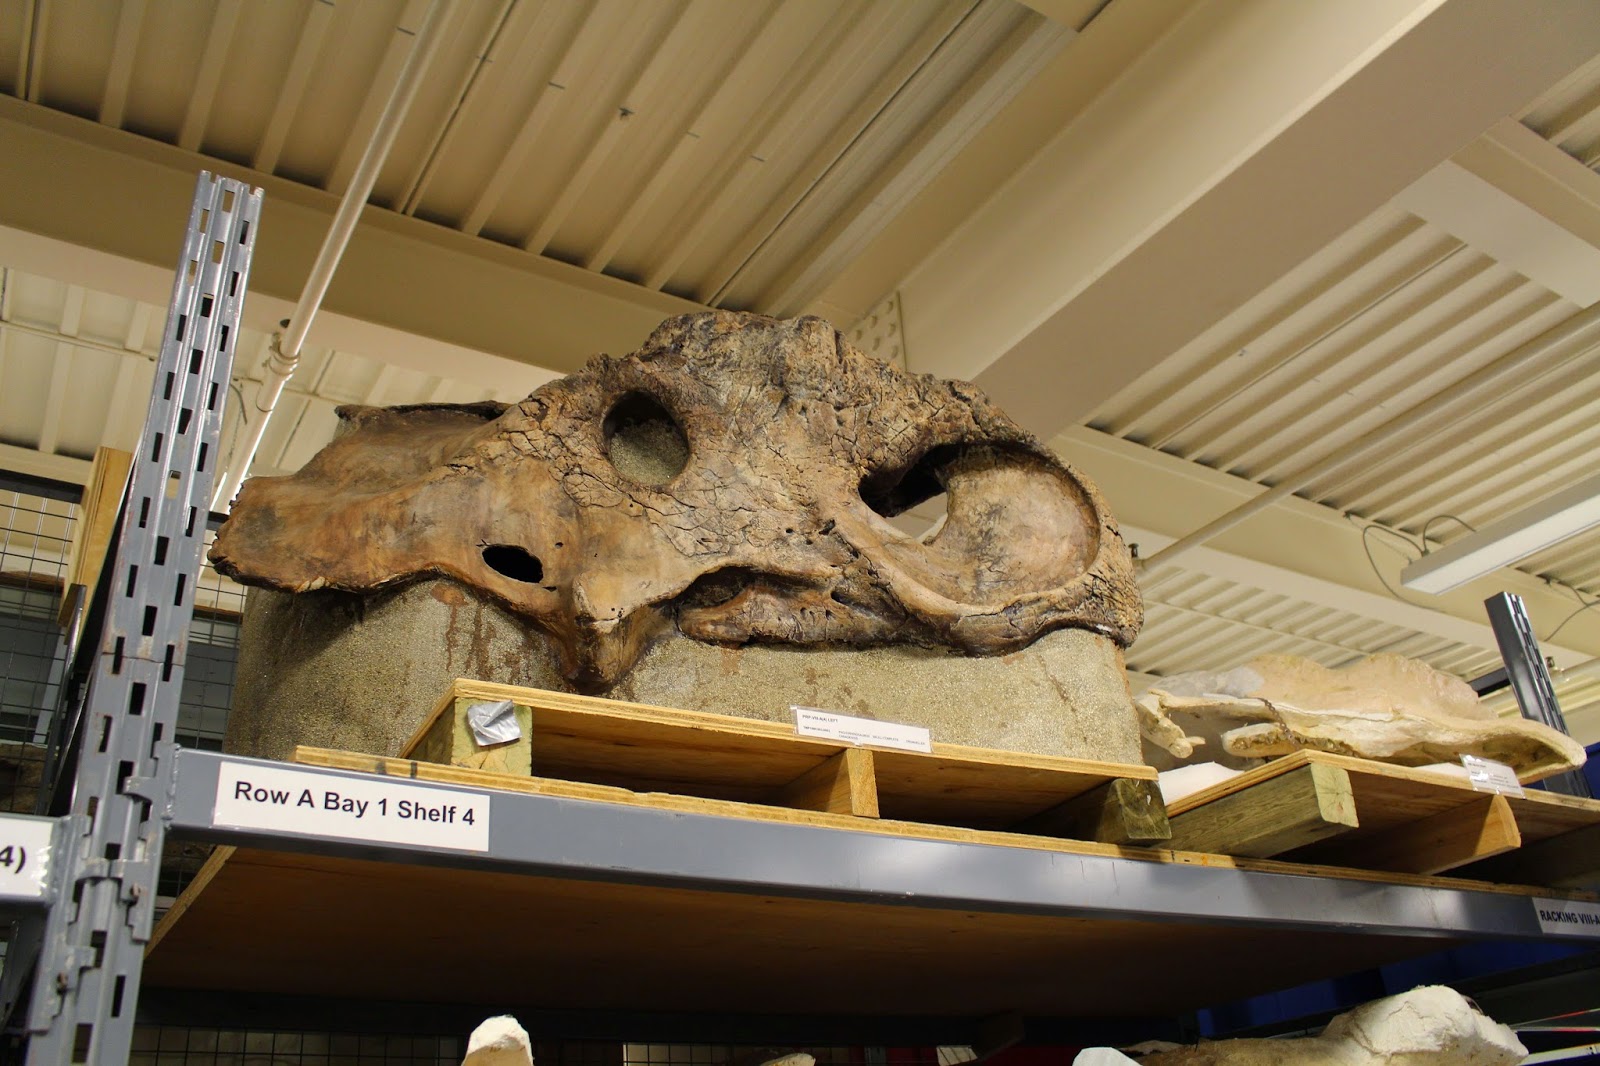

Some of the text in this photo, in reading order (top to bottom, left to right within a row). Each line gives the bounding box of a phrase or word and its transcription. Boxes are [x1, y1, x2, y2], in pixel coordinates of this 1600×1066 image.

[234, 781, 475, 825] Row A Bay 1 Shelf 4
[1540, 910, 1579, 924] RACKING
